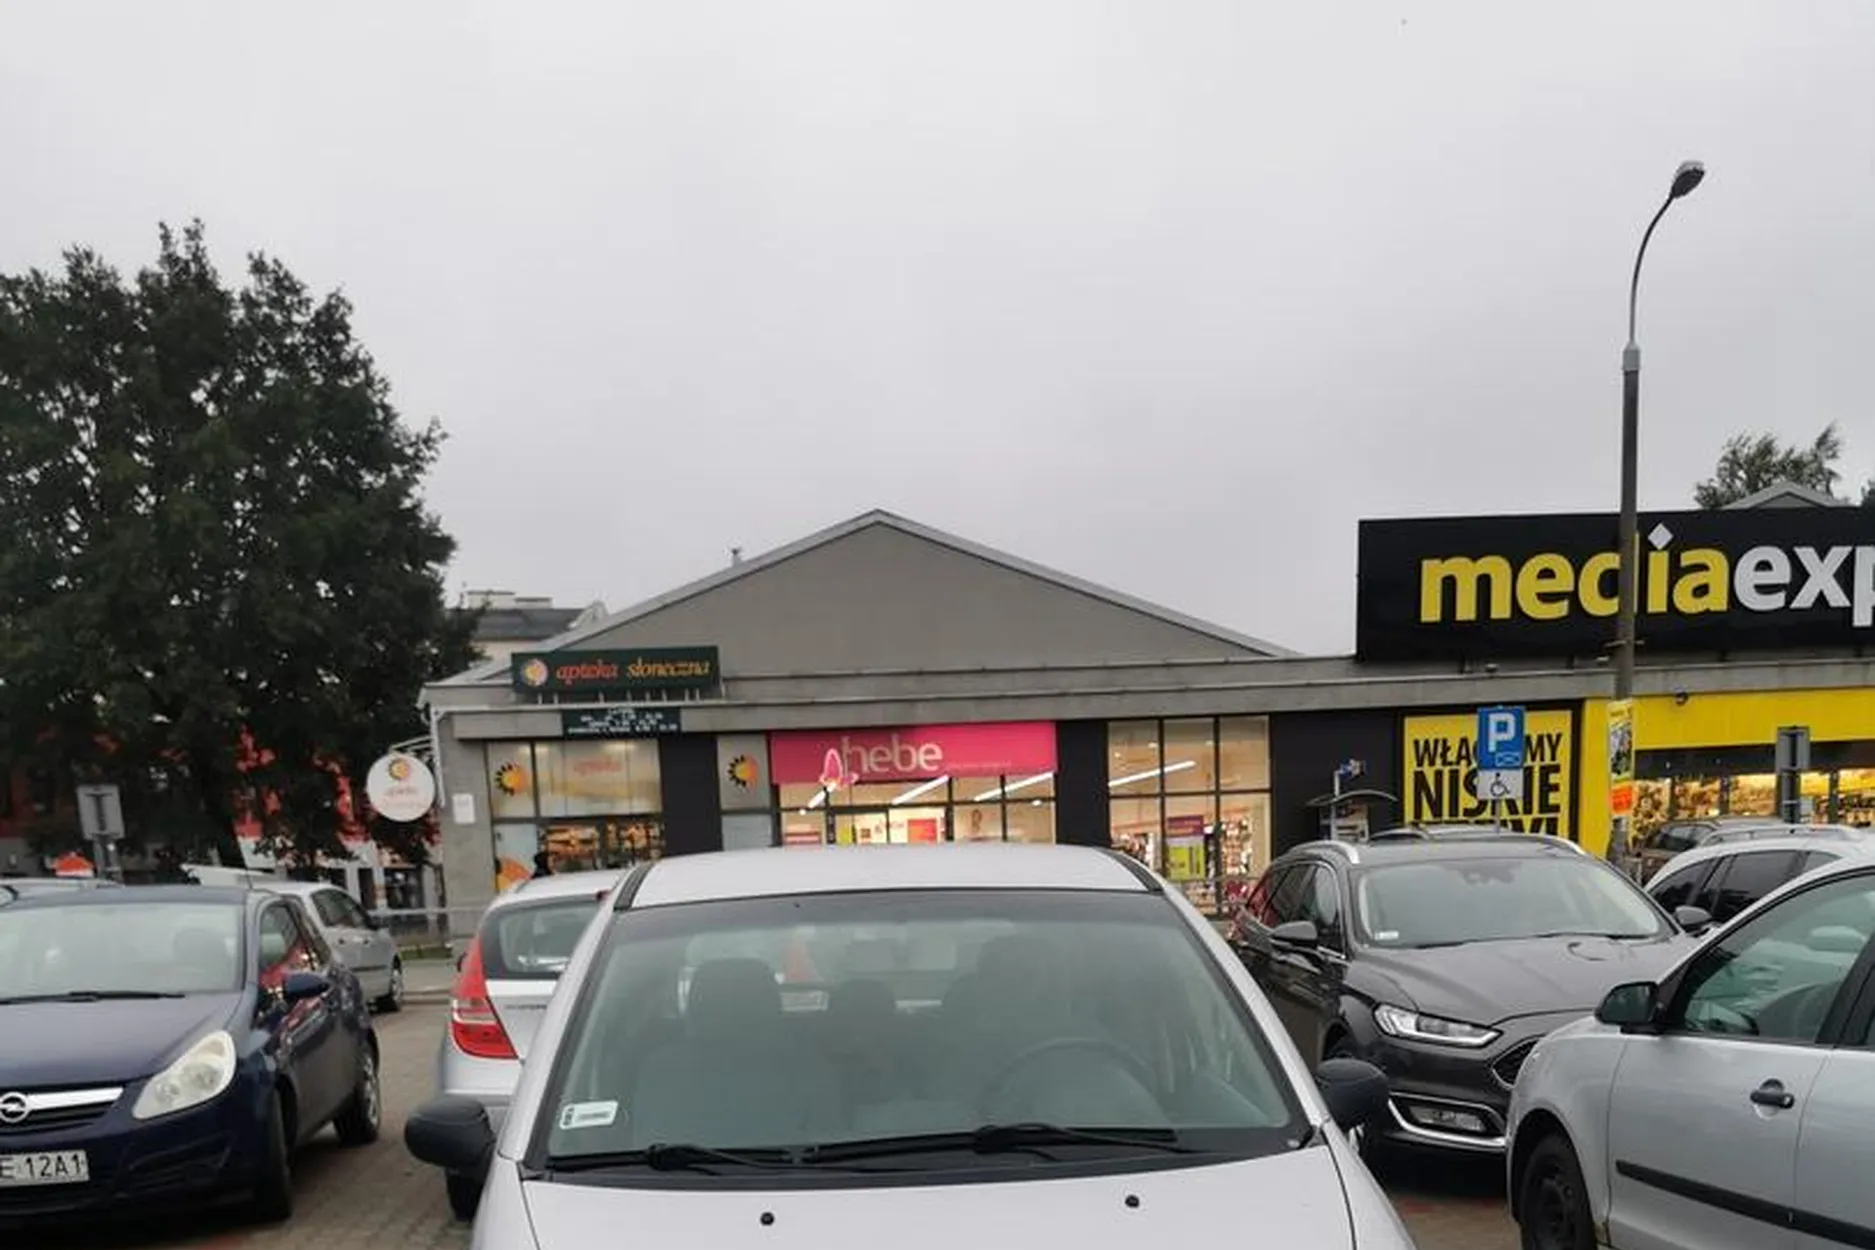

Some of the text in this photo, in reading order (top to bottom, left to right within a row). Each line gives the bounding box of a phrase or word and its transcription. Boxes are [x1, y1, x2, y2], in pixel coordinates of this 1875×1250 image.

[556, 658, 618, 685] apteka
[1488, 712, 1517, 753] P
[841, 734, 943, 774] hebe
[25, 1153, 81, 1178] 12A1
